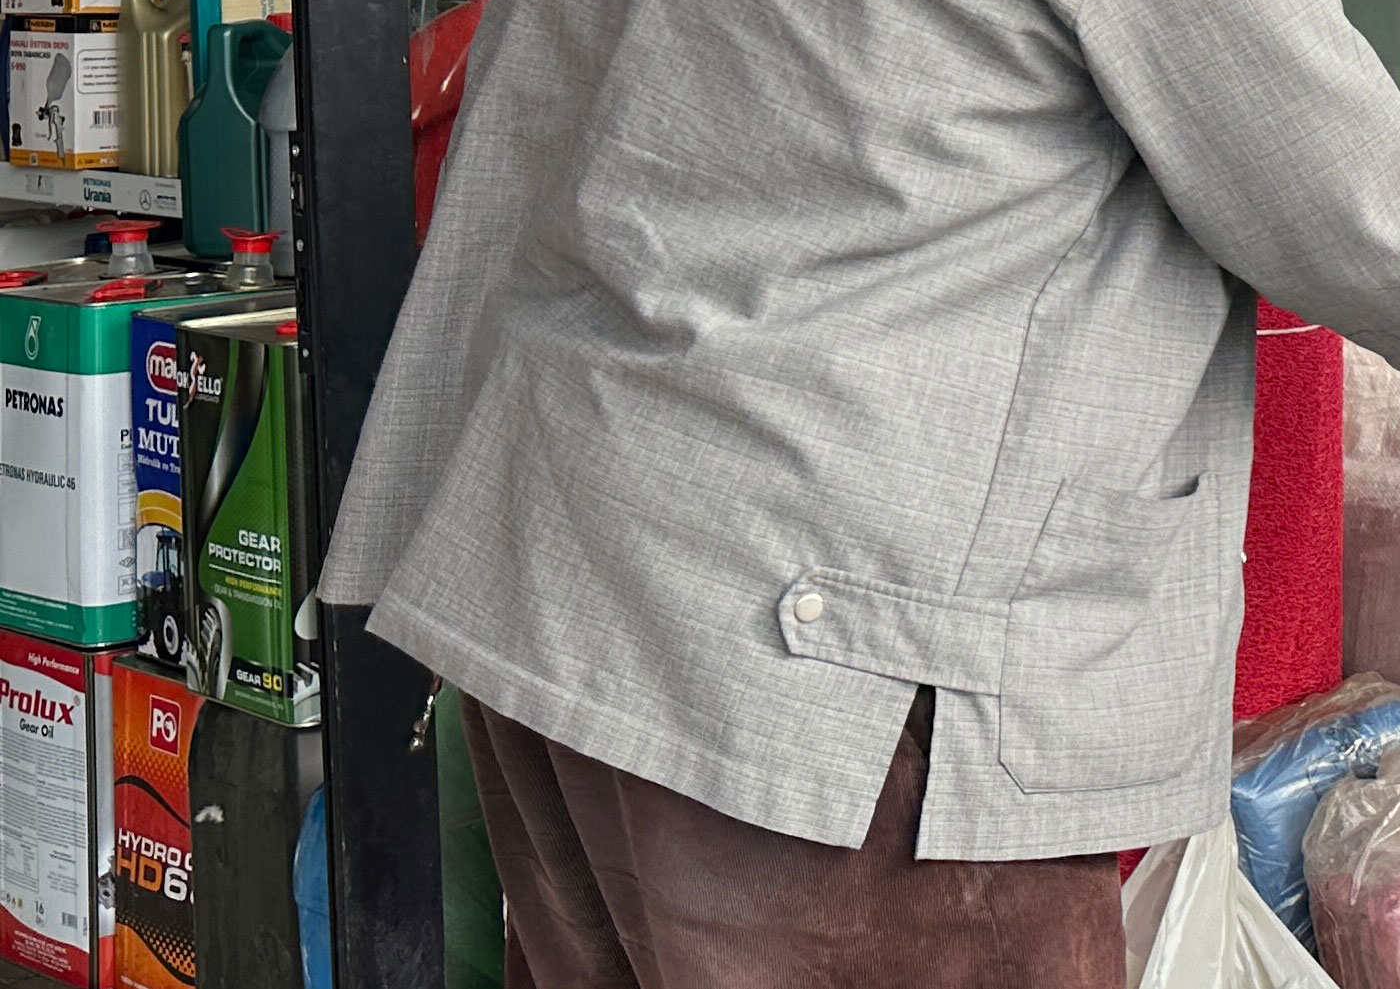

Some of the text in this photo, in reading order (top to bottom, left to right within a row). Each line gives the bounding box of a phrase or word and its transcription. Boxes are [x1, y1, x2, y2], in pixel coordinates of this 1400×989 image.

[83, 188, 111, 203] Urania
[5, 388, 64, 418] PETRONAS
[0, 463, 76, 491] ETRONAS HYDRAULIC 46
[239, 529, 281, 554] GEAR
[208, 542, 281, 572] PROTECTOR
[28, 652, 80, 674] High Performance
[236, 669, 283, 692] GEAR 90
[0, 678, 75, 725] Prolux
[19, 718, 54, 738] Gear Oil
[118, 827, 182, 867] HYDRO
[117, 846, 194, 905] HD6
